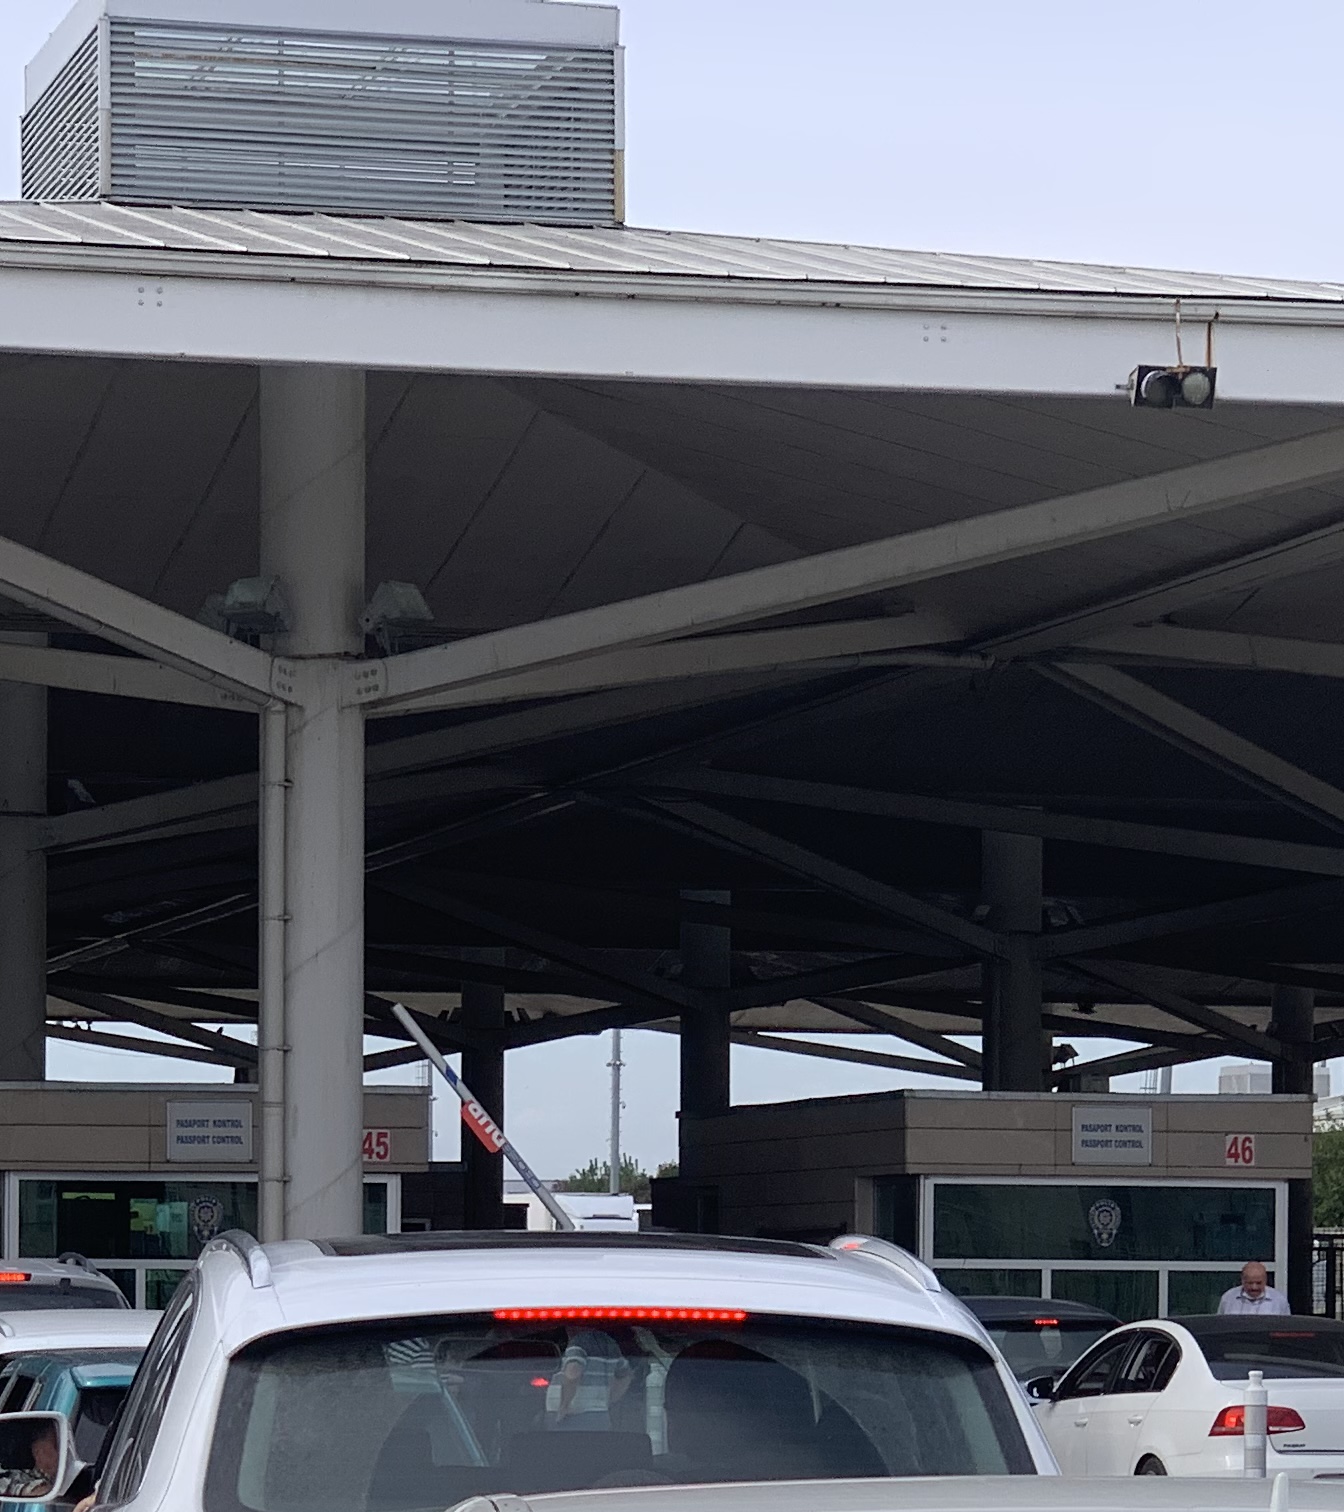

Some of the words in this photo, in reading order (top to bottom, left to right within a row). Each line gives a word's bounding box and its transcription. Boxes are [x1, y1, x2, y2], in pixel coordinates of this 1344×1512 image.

[176, 1118, 209, 1129] PASAPORT
[212, 1119, 244, 1129] KONTROL
[1081, 1123, 1112, 1133] PASAPORT
[1115, 1124, 1144, 1134] KONTROL
[176, 1134, 210, 1145] PASSPORT
[212, 1135, 244, 1145] CONTROL
[1081, 1139, 1113, 1149] PASSPORT
[1114, 1139, 1144, 1149] CONTROL
[362, 1131, 389, 1160] 45
[1226, 1136, 1254, 1164] 46
